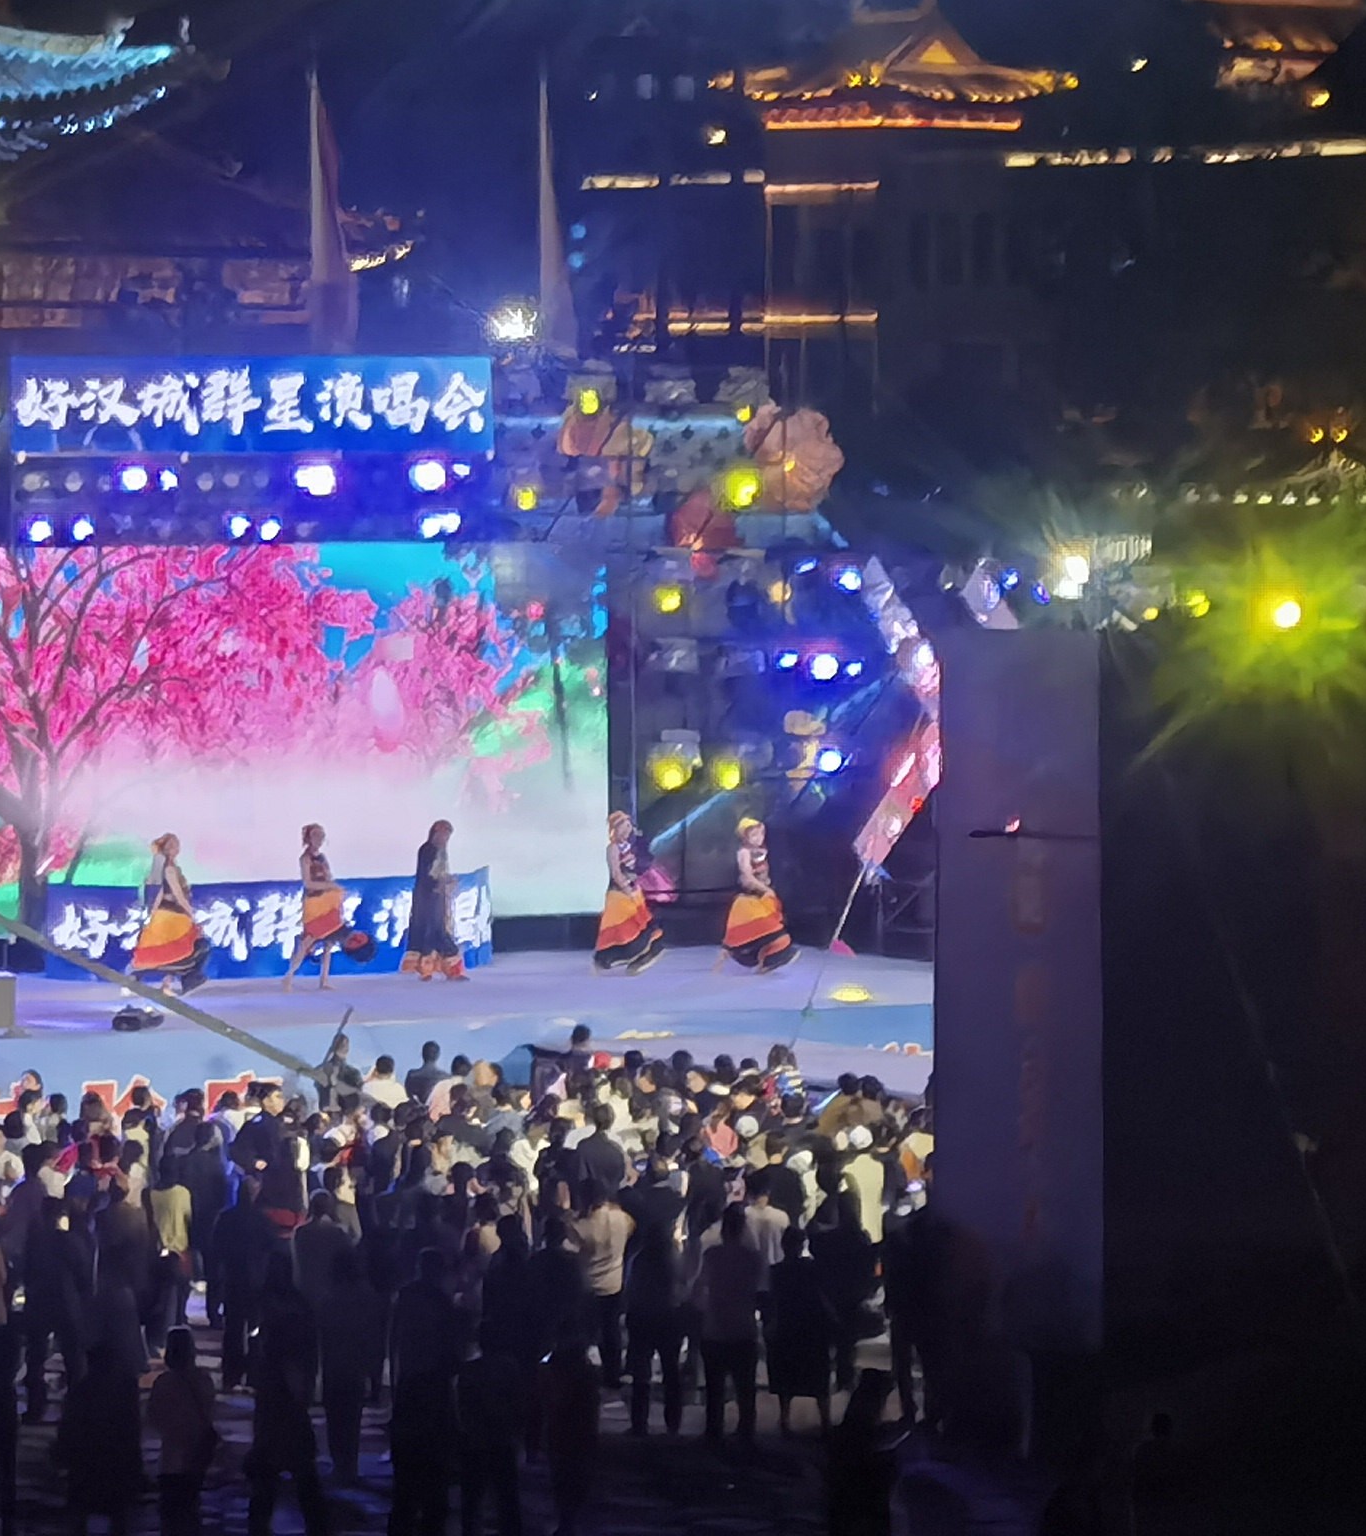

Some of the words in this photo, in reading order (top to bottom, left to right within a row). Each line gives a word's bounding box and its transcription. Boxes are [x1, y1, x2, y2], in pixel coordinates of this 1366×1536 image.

[15, 367, 486, 434] 好汉城群星演唱会
